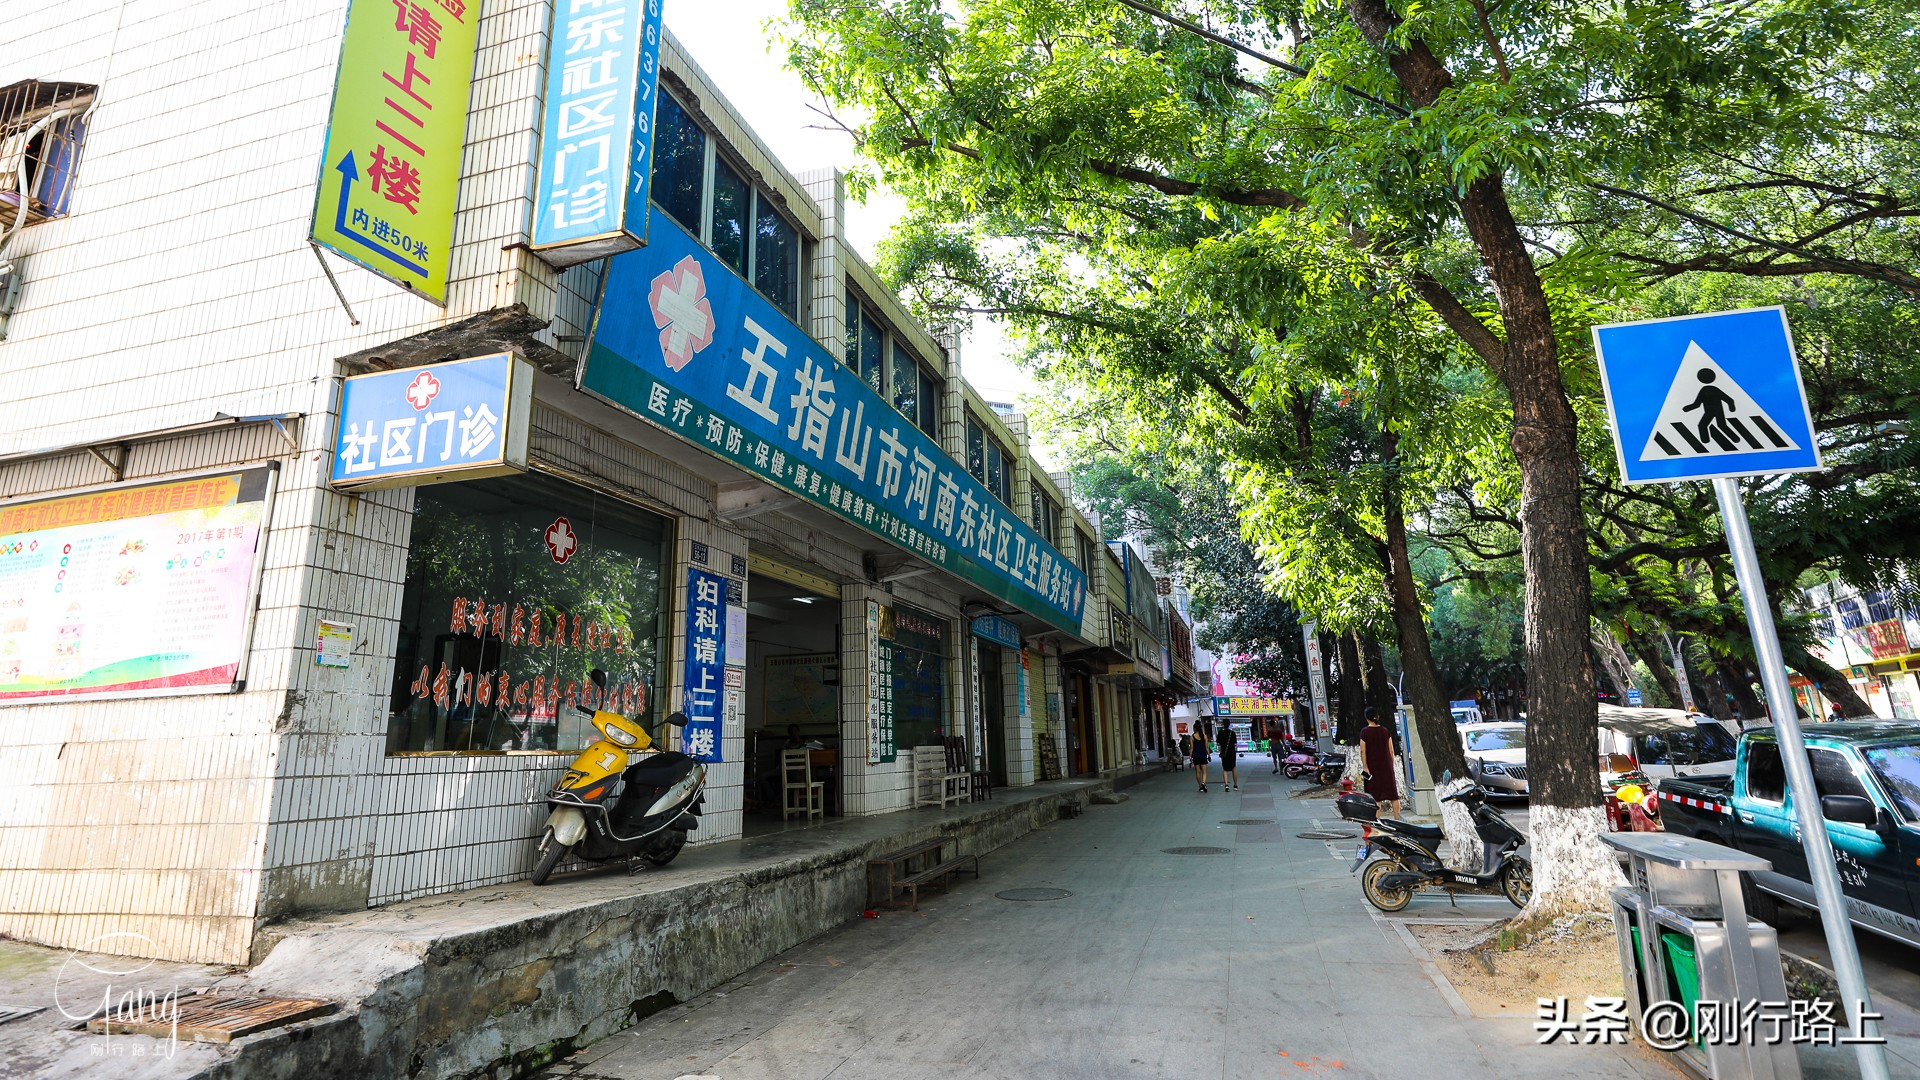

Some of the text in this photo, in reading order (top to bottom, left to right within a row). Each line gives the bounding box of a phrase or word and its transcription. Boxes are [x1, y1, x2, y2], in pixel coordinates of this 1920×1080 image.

[351, 207, 429, 263] 内进50米
[340, 402, 499, 475] 社区门诊
[647, 381, 947, 564] 医疗 预防 保健 康复 健康教育 计划生育宣传咨询
[726, 315, 1072, 612] 五指山市河南东社区卫生服务站
[177, 525, 244, 545] 2017年第1期
[690, 575, 719, 759] 妇科请上二楼
[596, 752, 618, 772] 1
